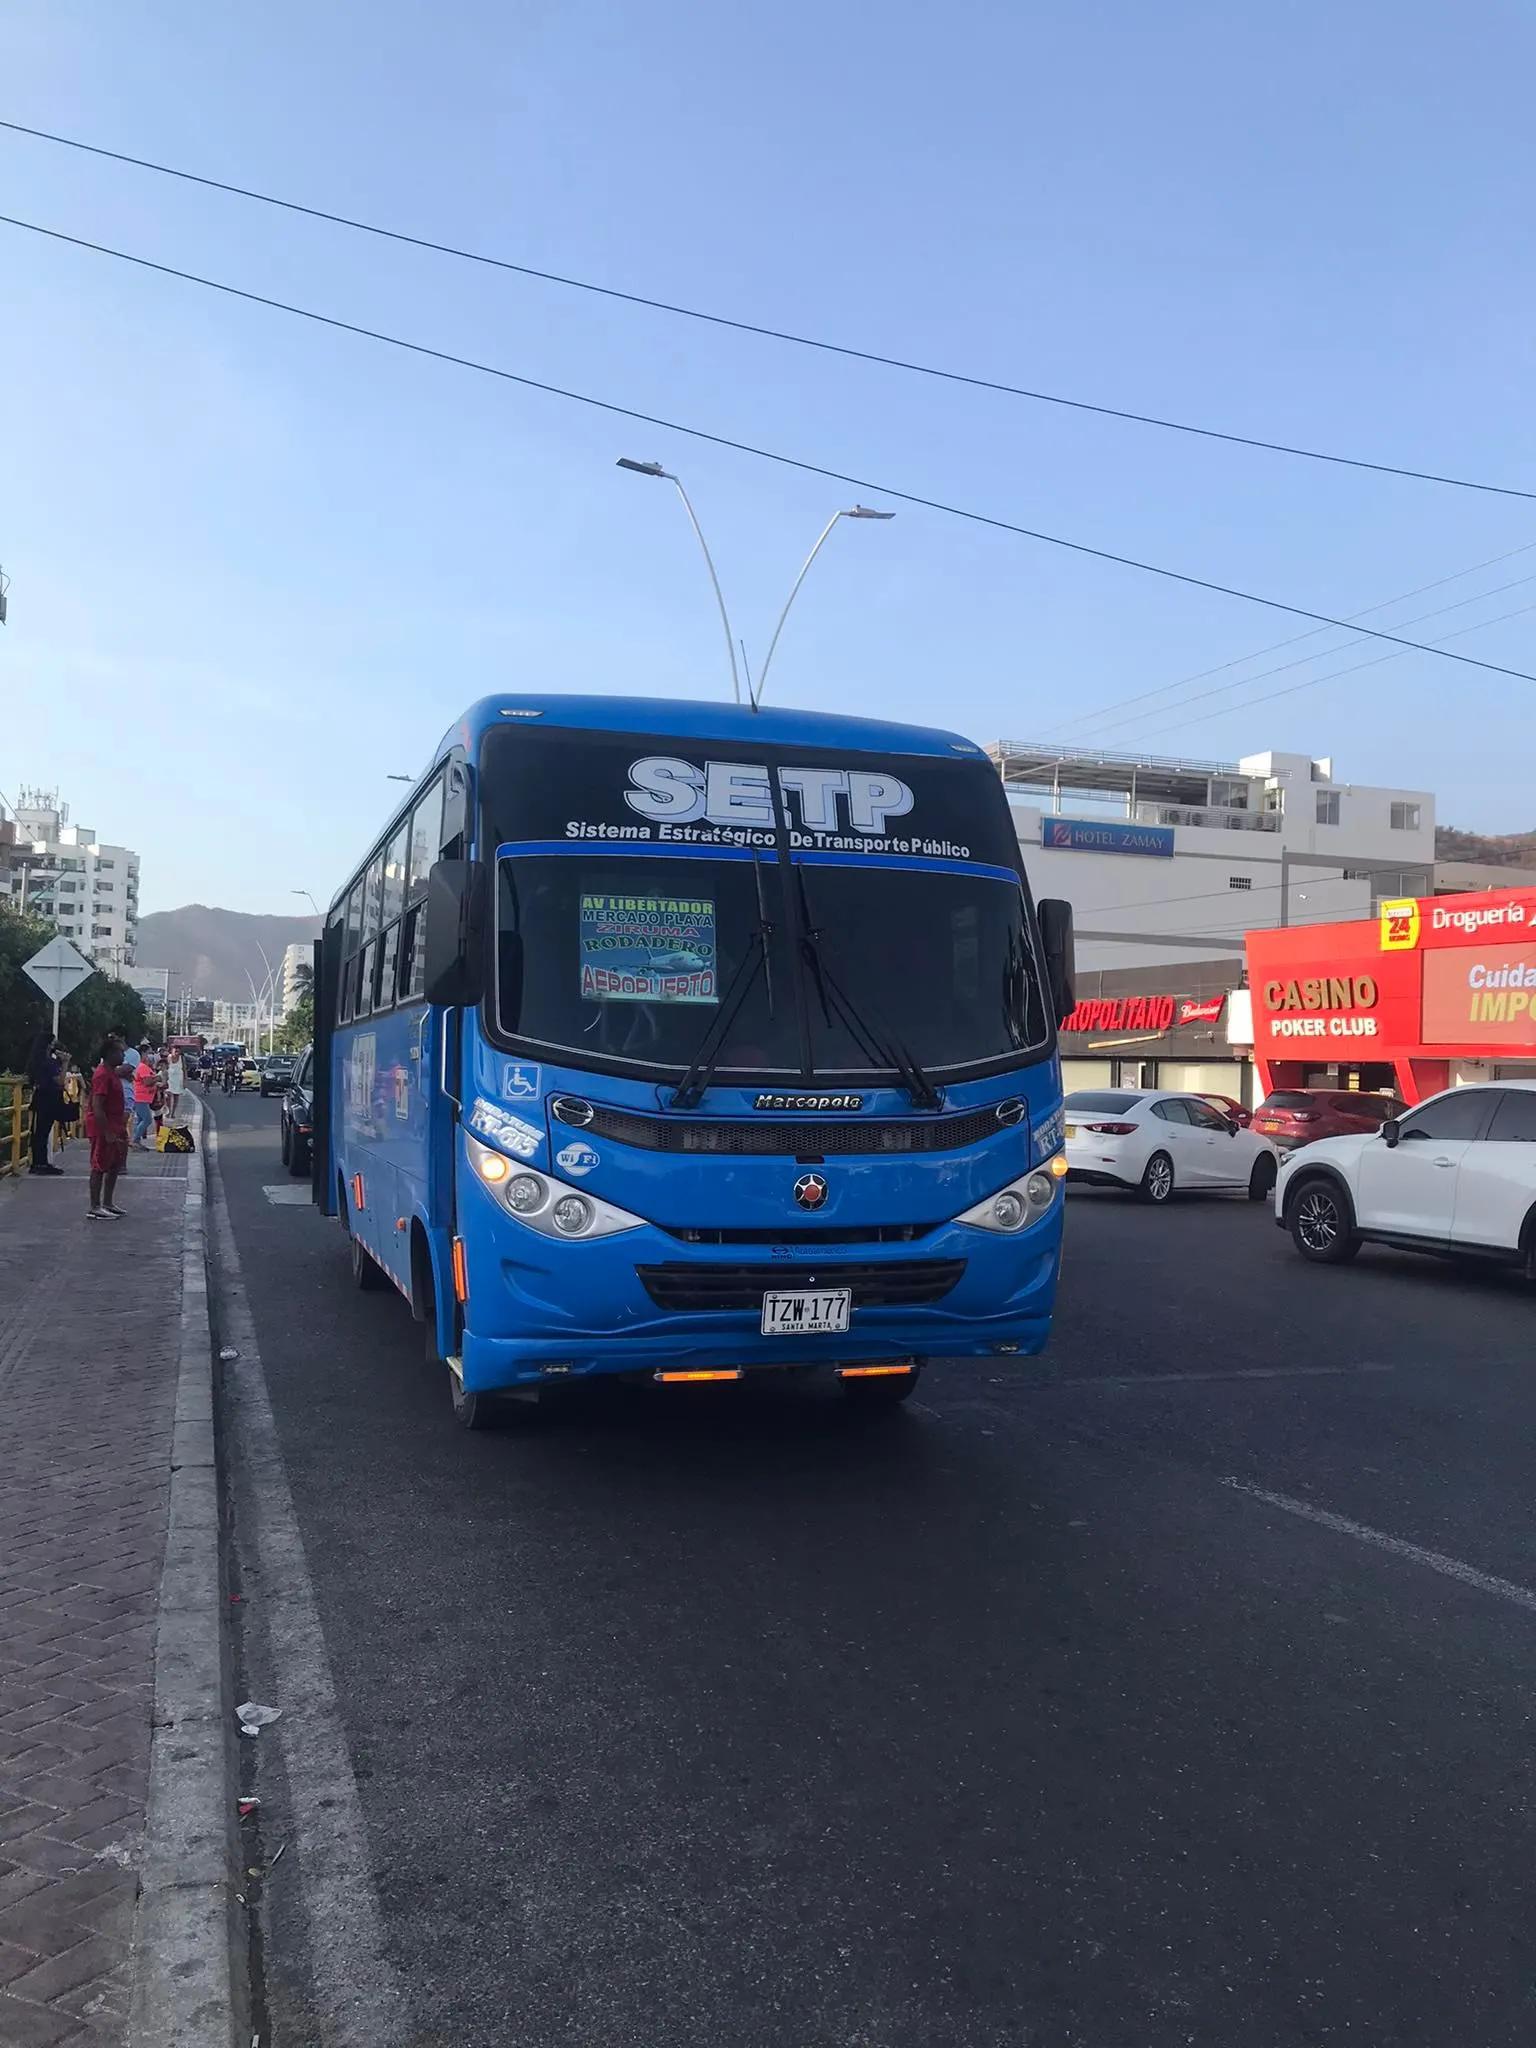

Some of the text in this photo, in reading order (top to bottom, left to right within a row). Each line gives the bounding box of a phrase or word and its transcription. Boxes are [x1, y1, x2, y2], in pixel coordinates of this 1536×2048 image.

[624, 757, 915, 834] SETP
[565, 821, 650, 839] Sistema
[658, 824, 776, 848] Estratégico
[911, 838, 970, 858] Público
[1075, 829, 1165, 849] HOTEL ZAMAY
[582, 897, 713, 915] AV LIBERTADOR
[583, 909, 713, 928] MERCADO PLAYA
[1388, 917, 1411, 934] 24
[1432, 902, 1525, 933] Droguería
[596, 922, 701, 937] ZIRUMA
[583, 935, 713, 957] RODADERO
[582, 963, 714, 997] AEROPUERTO
[1263, 975, 1378, 1011] CASINO
[1271, 1016, 1379, 1037] POKER CLUB
[756, 1094, 860, 1110] Marcopolo
[768, 1296, 846, 1322] TZW 177
[781, 1321, 831, 1331] SANTA MARTA
